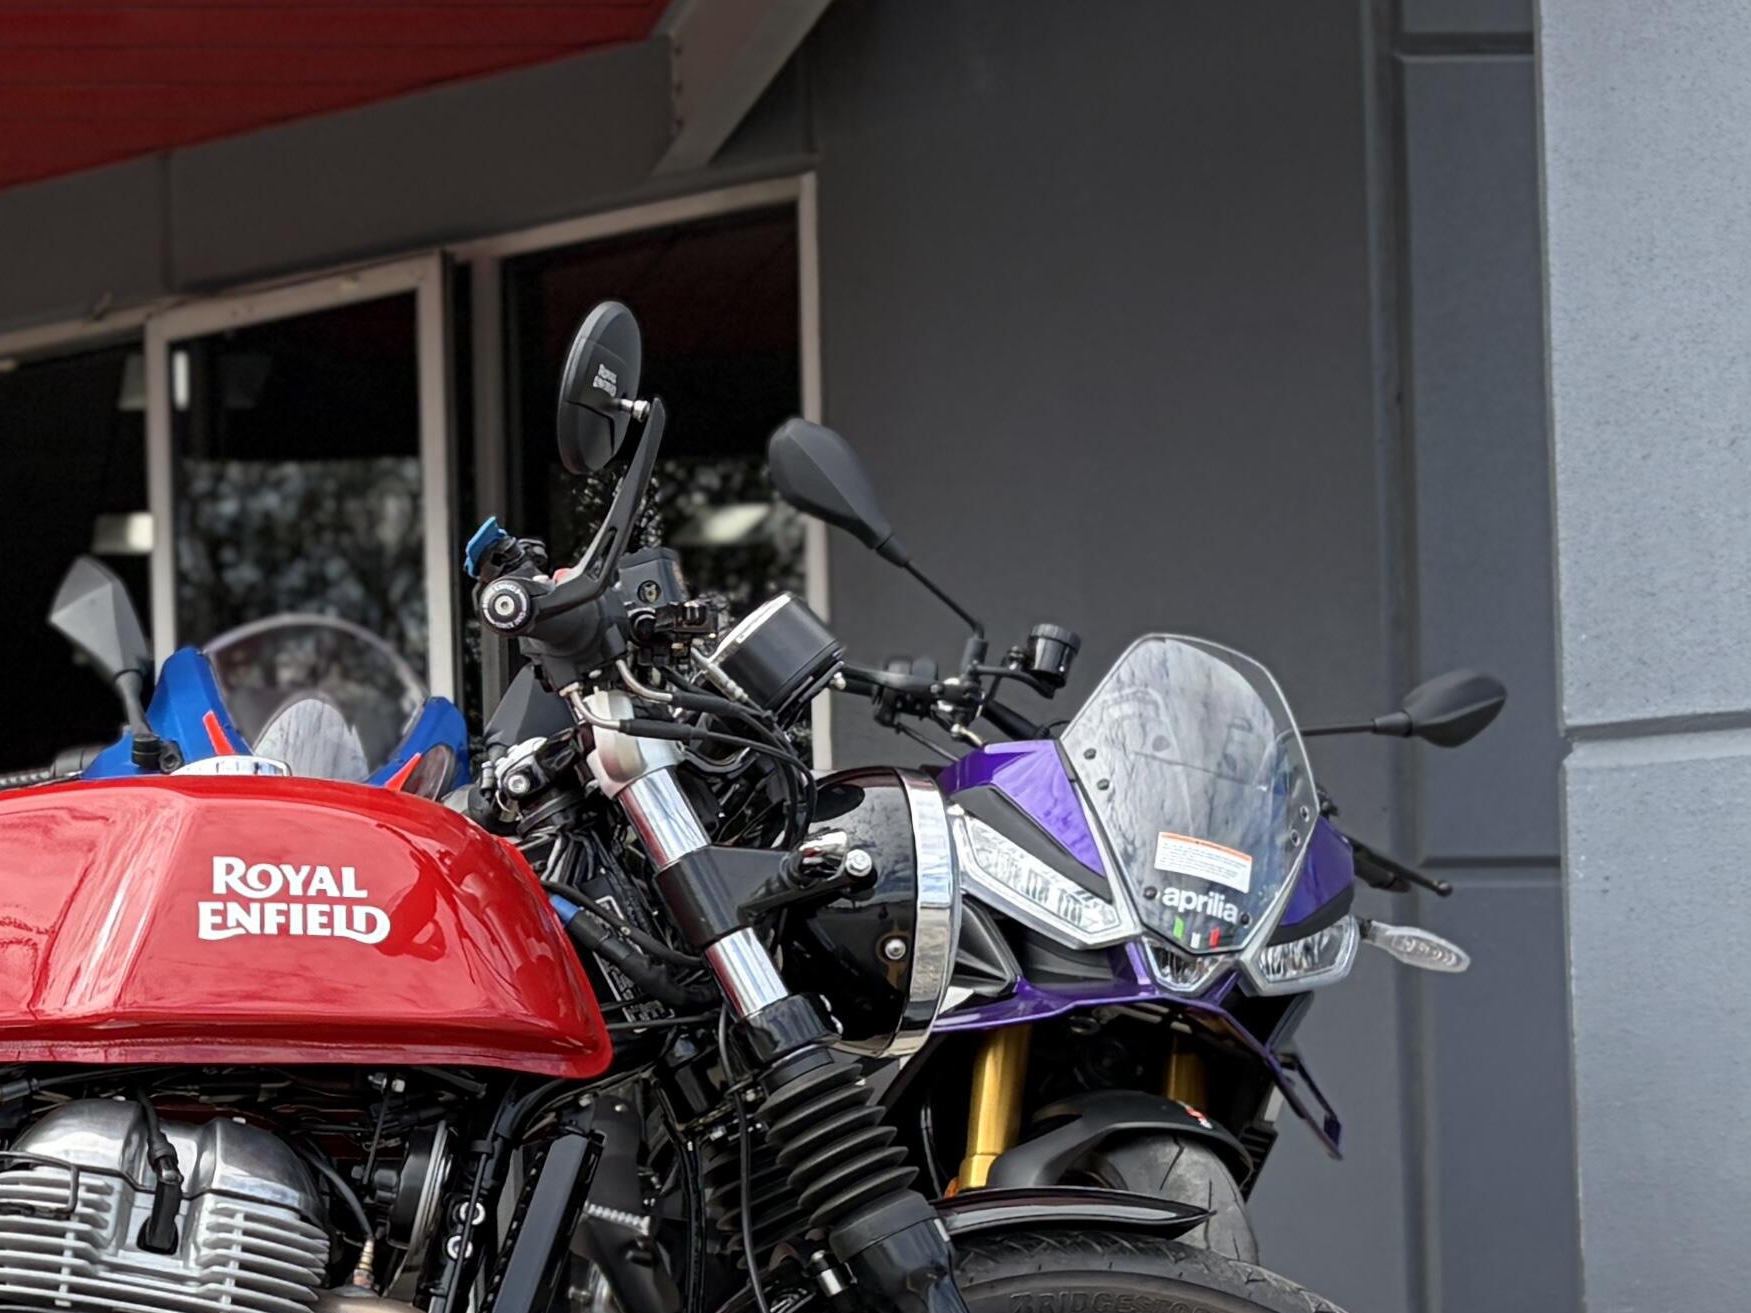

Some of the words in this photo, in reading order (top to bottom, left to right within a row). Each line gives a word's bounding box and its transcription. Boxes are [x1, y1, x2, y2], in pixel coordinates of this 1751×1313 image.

[213, 856, 368, 899] ROYAL
[198, 901, 391, 944] ENFIELD
[1161, 886, 1239, 924] aprilia
